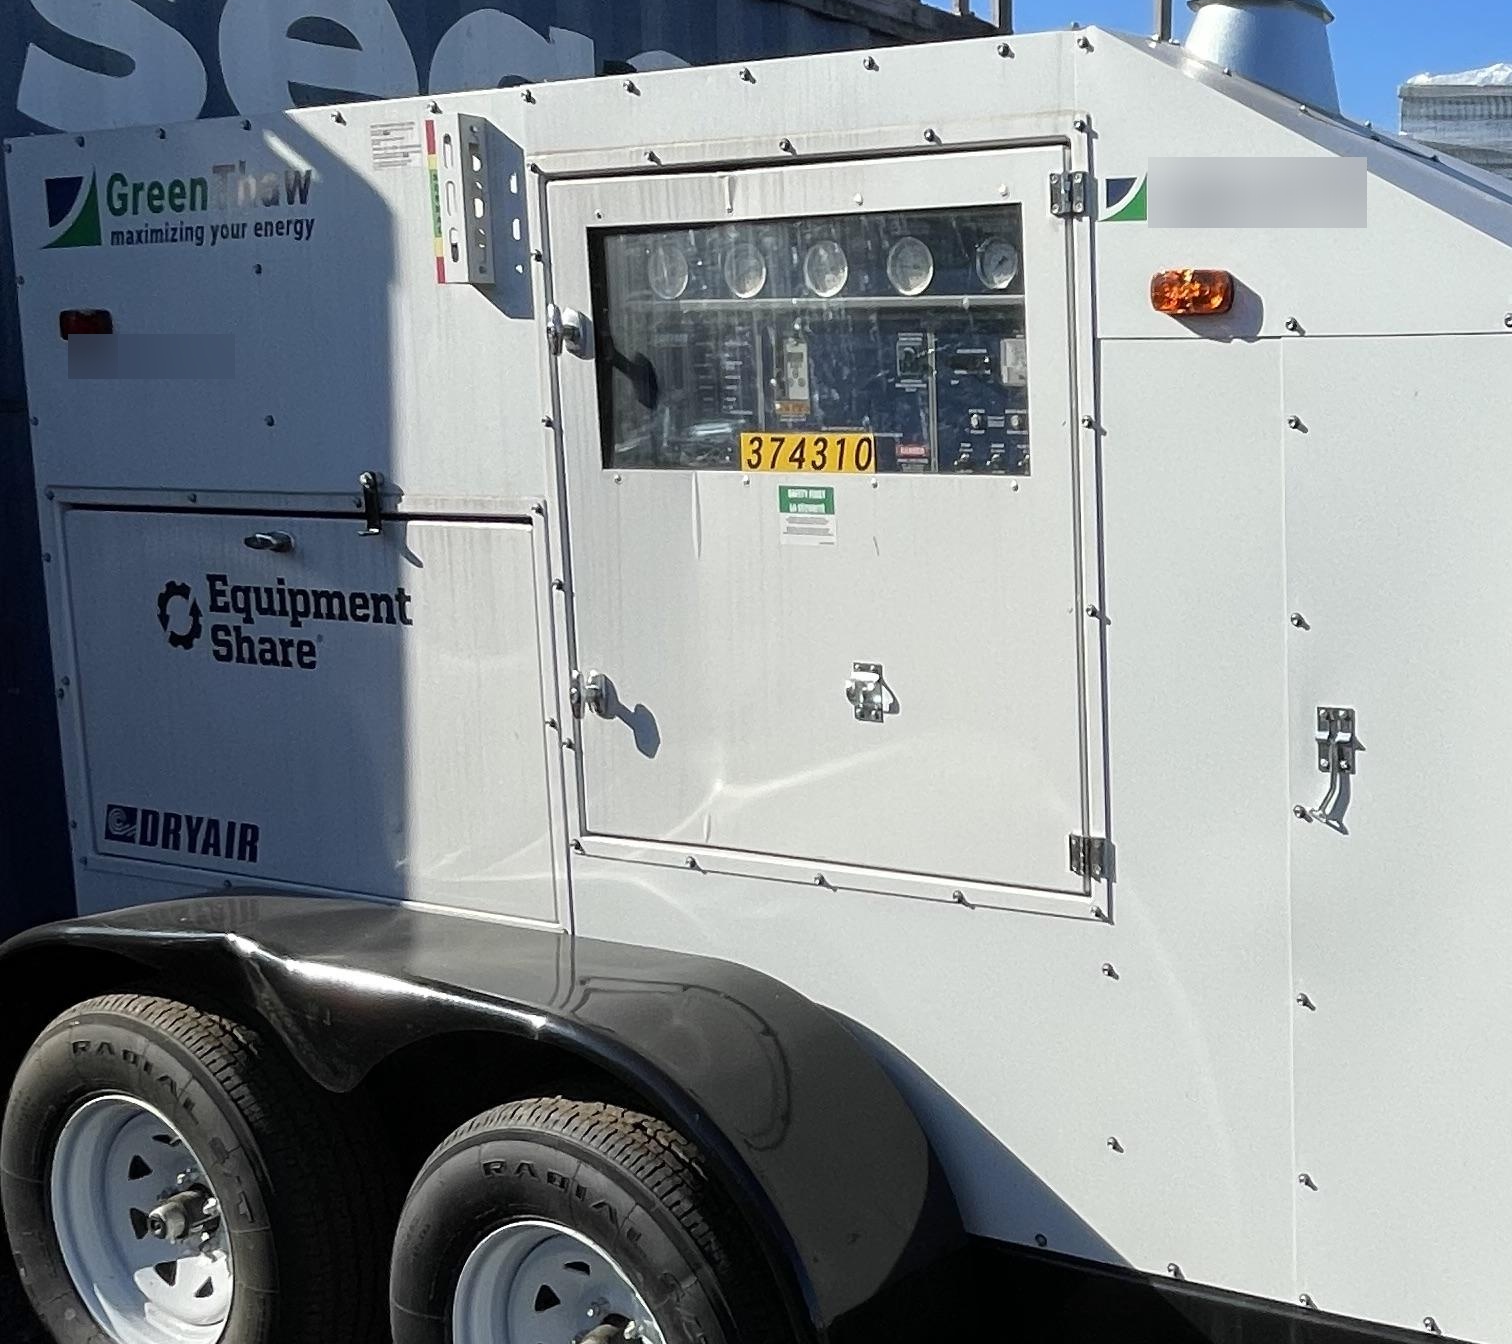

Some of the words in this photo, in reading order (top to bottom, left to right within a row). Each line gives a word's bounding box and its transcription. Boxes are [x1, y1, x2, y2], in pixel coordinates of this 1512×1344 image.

[110, 222, 205, 247] maximizing
[210, 220, 248, 246] your
[253, 215, 316, 242] energy
[746, 436, 873, 472] 374310
[205, 573, 414, 629] Equipment
[138, 808, 261, 863] DRYAIR
[71, 1039, 204, 1125] RADIAL
[481, 1158, 650, 1248] RADIAL
